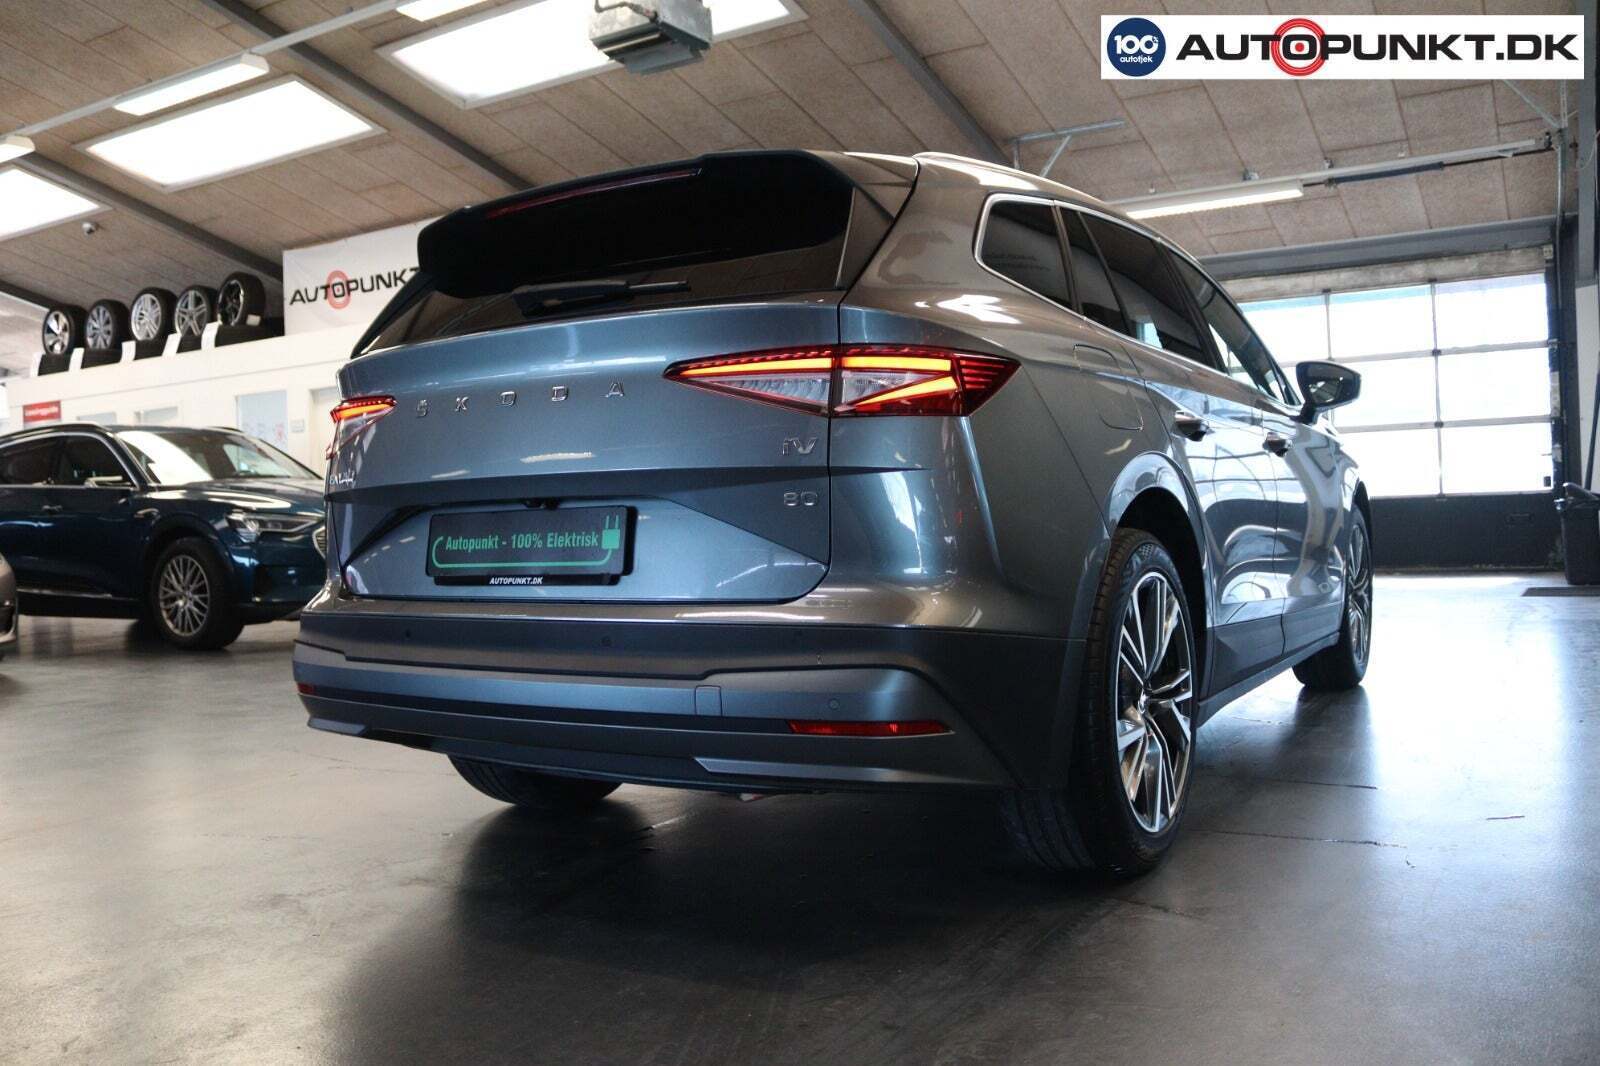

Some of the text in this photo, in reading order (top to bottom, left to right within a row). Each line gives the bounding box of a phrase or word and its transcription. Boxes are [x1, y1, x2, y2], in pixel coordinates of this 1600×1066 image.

[783, 491, 818, 507] 80
[445, 535, 499, 553] Autopunkt
[511, 533, 543, 549] 100%
[546, 531, 599, 548] Elektrisk
[489, 576, 543, 585] AUTOPUNKT.DK
